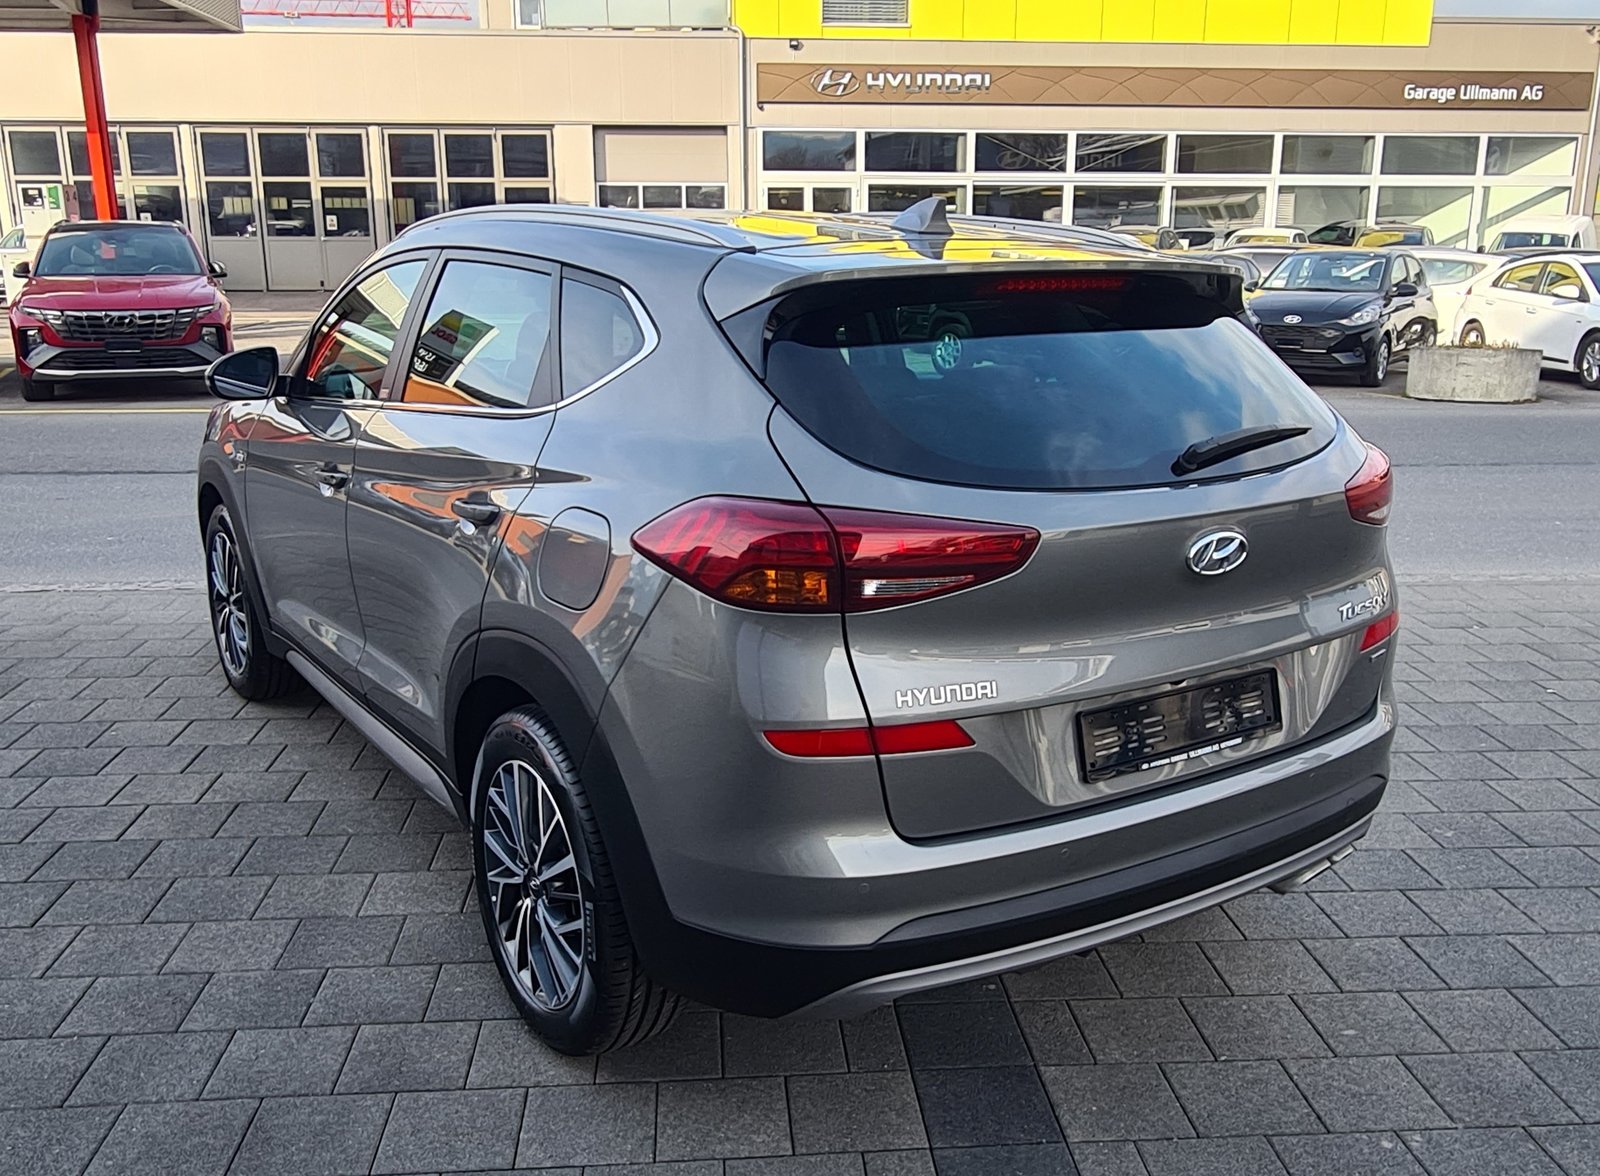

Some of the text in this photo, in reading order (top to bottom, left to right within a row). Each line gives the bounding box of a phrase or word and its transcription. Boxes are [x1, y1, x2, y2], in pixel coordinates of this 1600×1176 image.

[866, 72, 991, 94] HYUNDAI
[1404, 84, 1544, 103] Garage Ullmann AG
[896, 680, 997, 708] HYUNDAI
